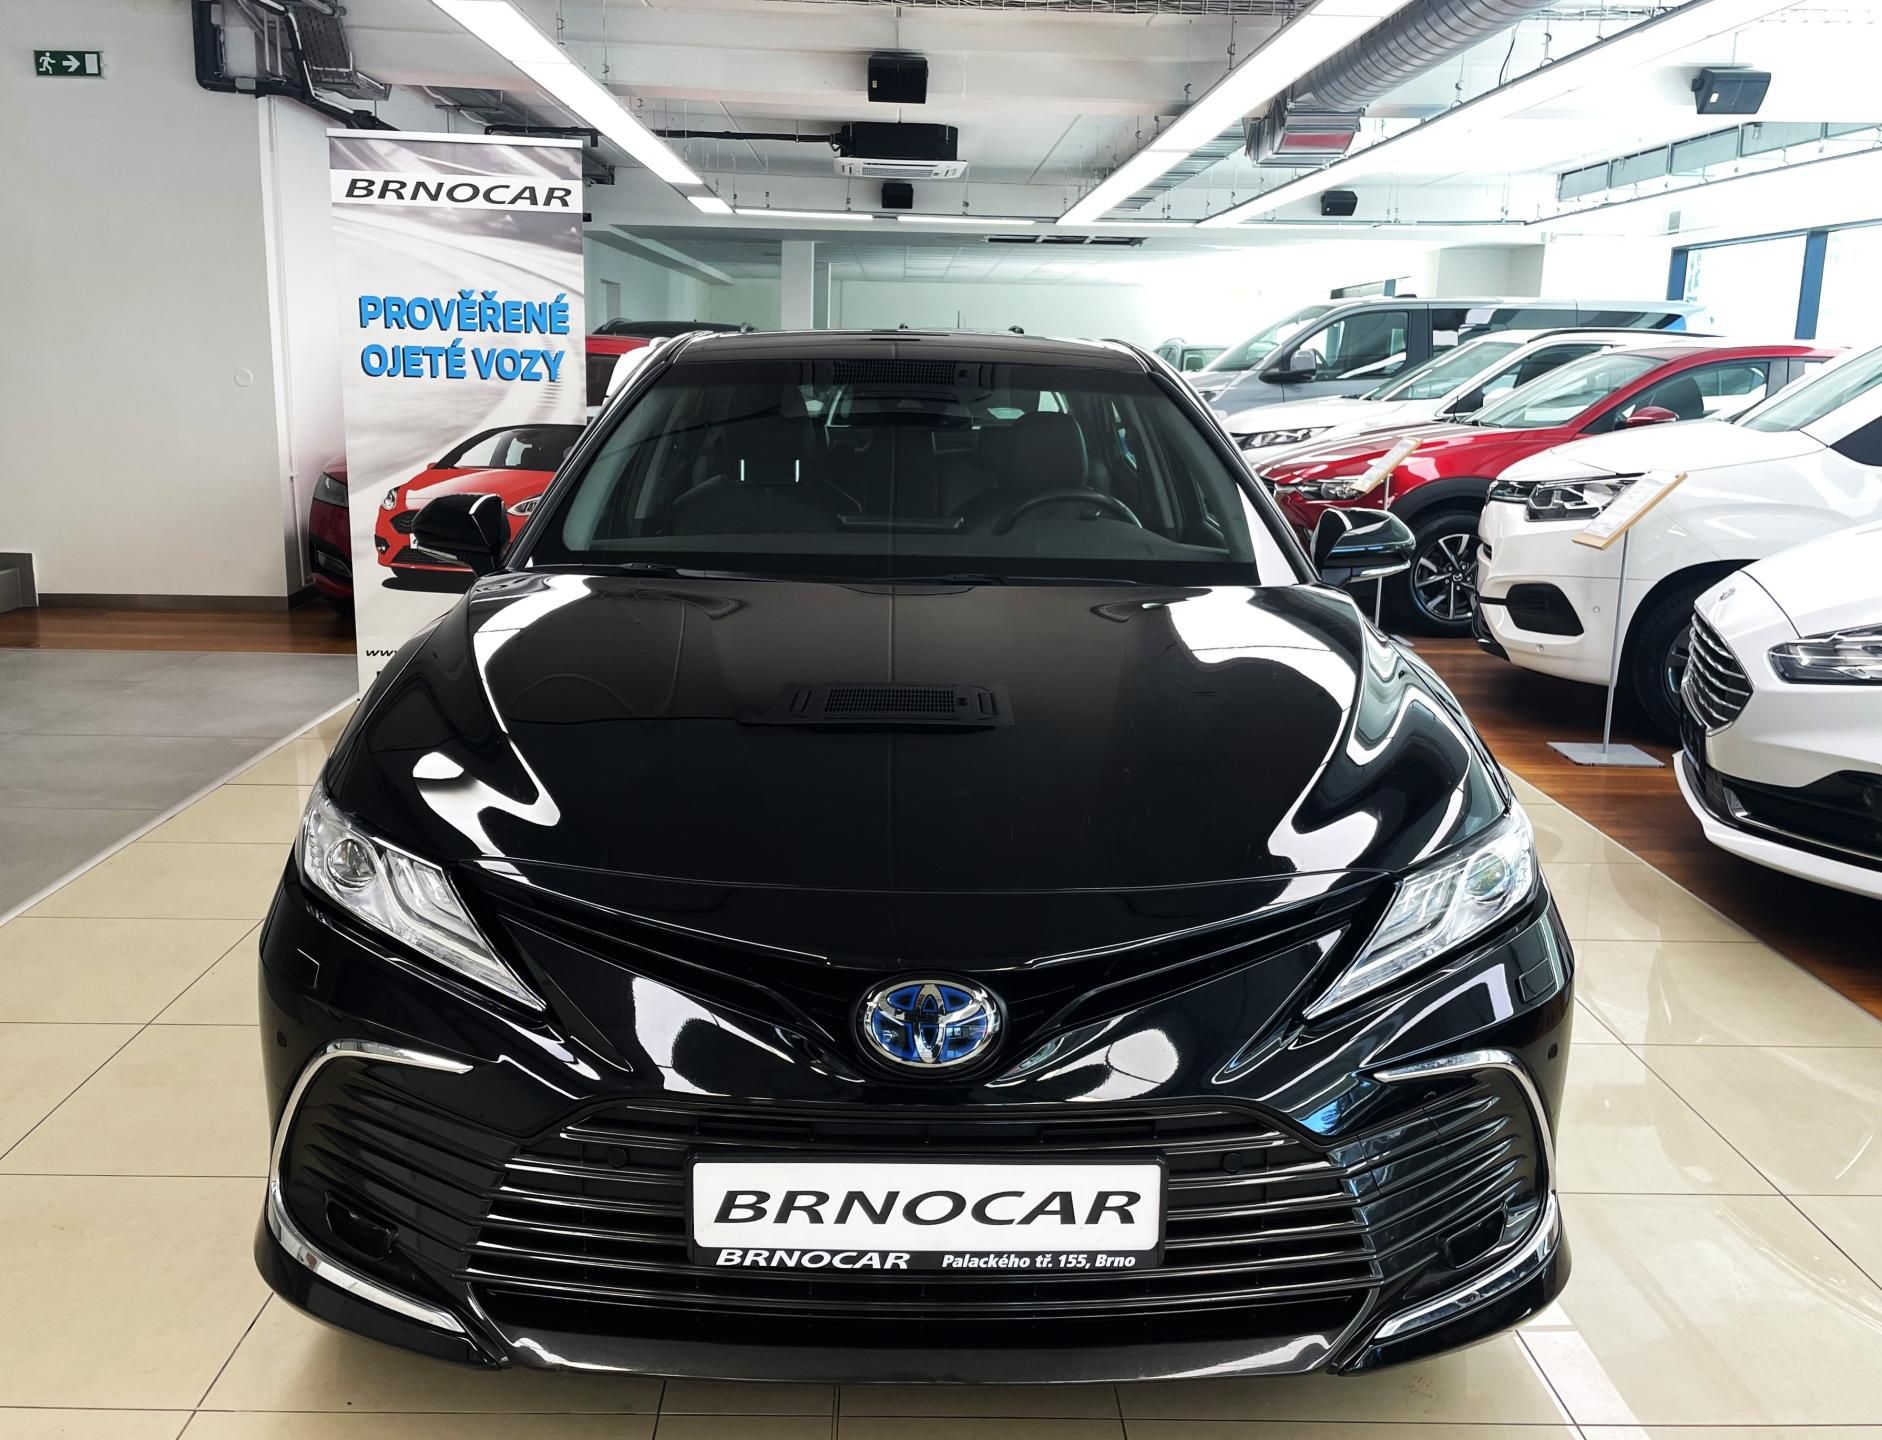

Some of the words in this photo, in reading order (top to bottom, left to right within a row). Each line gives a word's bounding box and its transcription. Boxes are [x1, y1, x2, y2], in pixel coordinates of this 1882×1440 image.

[345, 178, 572, 208] BRNOCAR
[358, 288, 571, 335] PROVĚŘENÉ
[360, 338, 467, 379] OJETÉ
[471, 347, 566, 382] VOZY
[713, 1190, 1141, 1226] BRNOCAR
[715, 1249, 911, 1270] BRNOCAR
[941, 1254, 1031, 1268] Palackého
[1035, 1254, 1053, 1268] tř.
[1058, 1255, 1091, 1269] 155,
[1095, 1255, 1136, 1267] Brno
